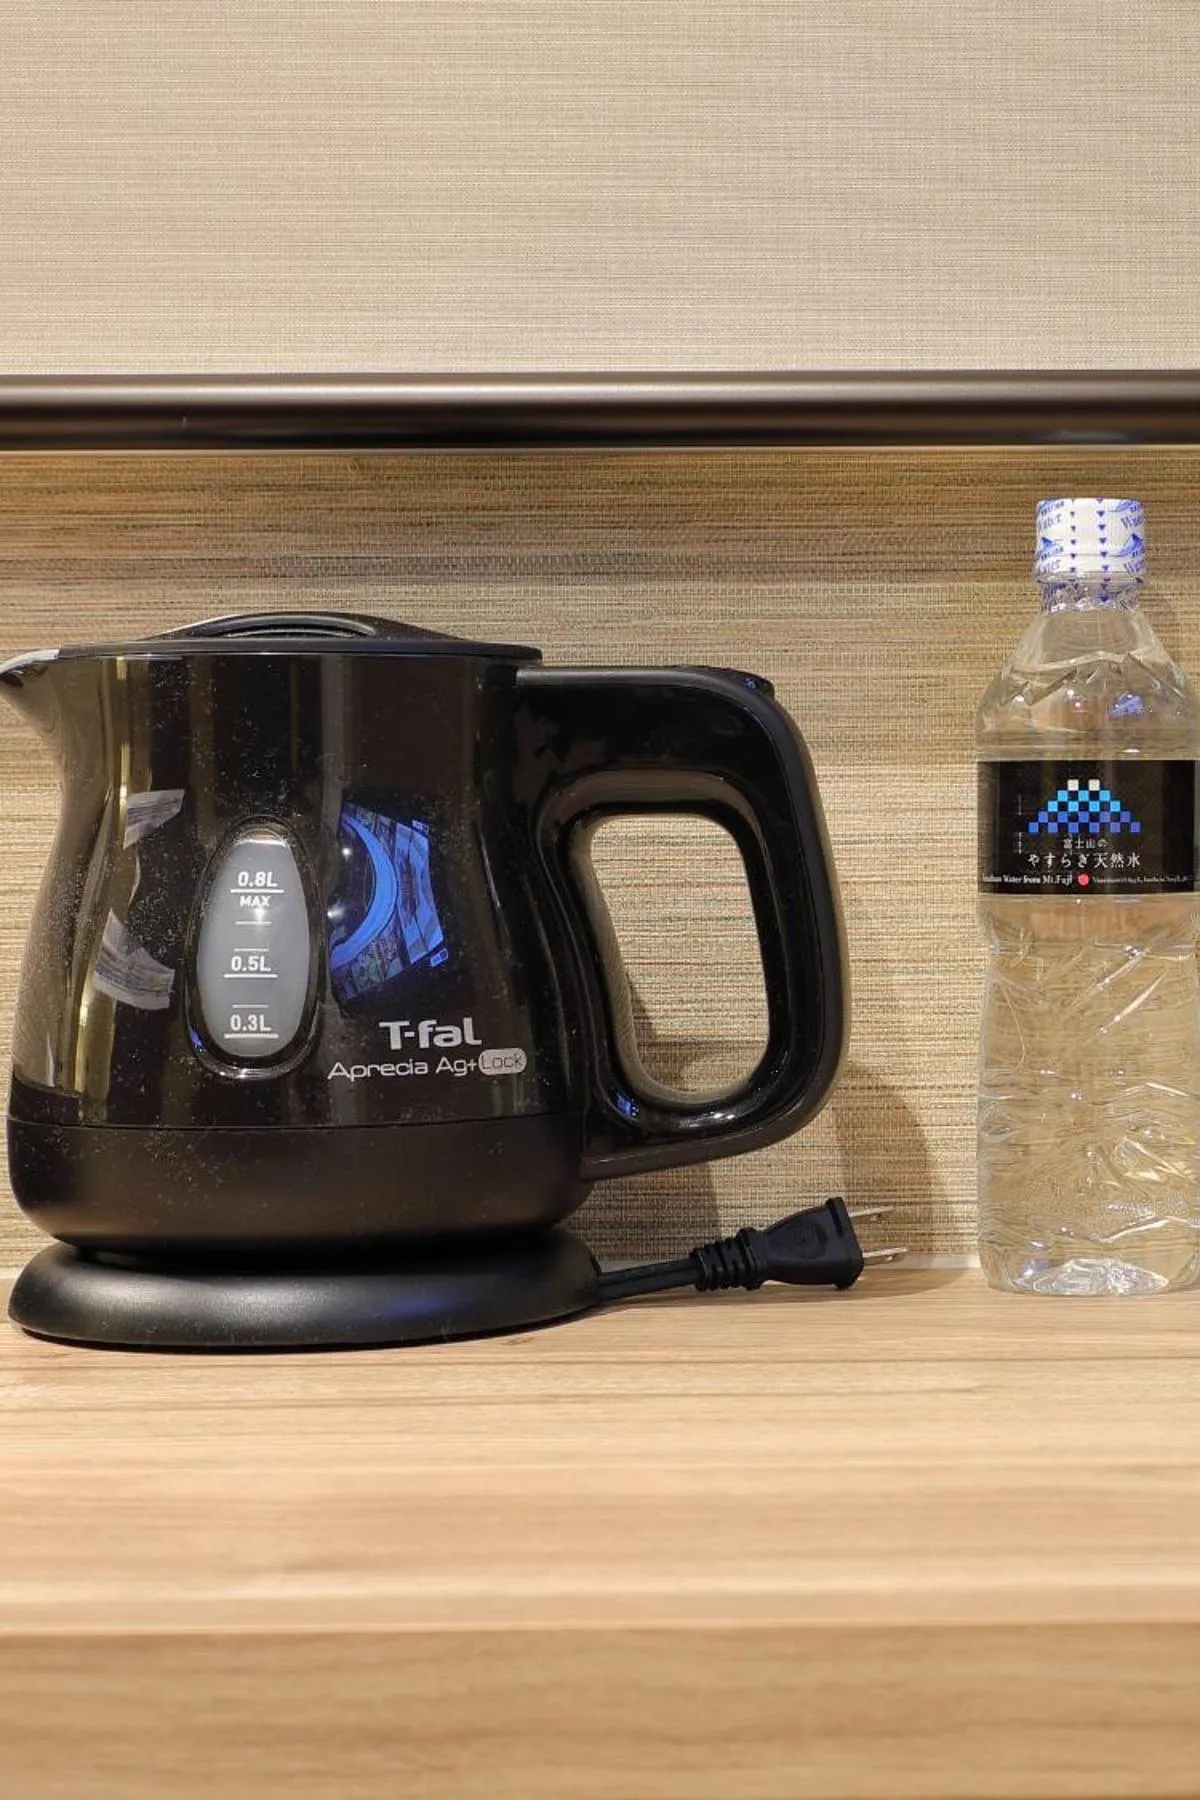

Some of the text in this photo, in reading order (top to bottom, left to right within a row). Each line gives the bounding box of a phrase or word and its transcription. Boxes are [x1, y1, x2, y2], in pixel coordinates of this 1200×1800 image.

[1063, 837, 1107, 850] 富士山の
[1027, 852, 1141, 869] やすらぎ天然水
[237, 871, 279, 887] 0.8L
[239, 895, 271, 908] MAX
[231, 956, 272, 972] 0.5L
[230, 1014, 272, 1032] 0.3L
[378, 1017, 483, 1050] T-fal
[327, 1058, 429, 1082] Aprecia
